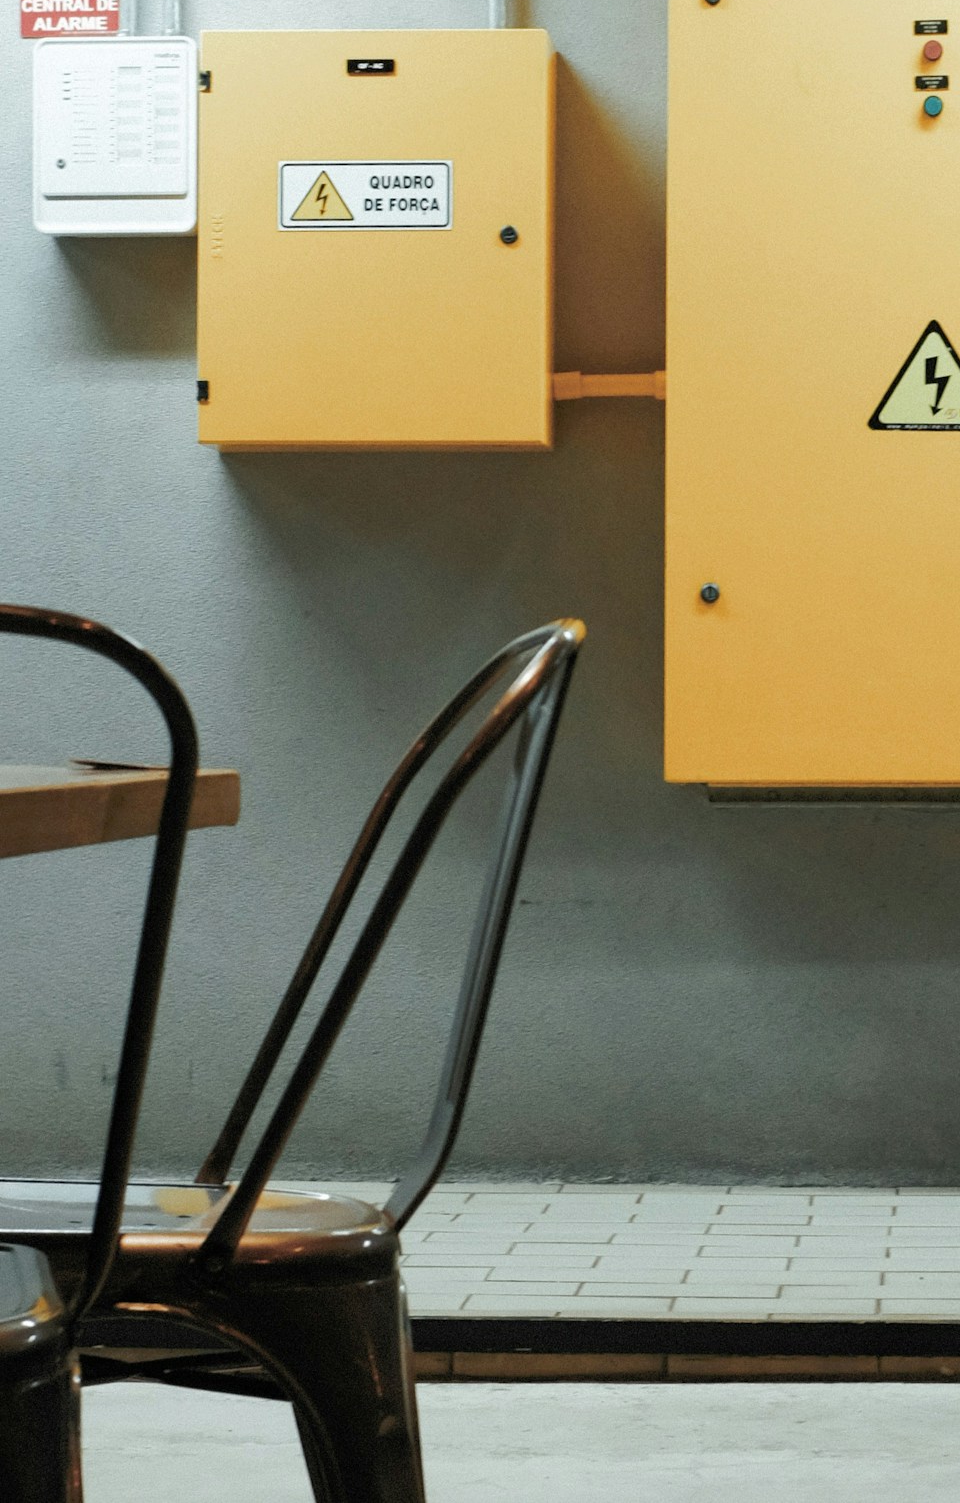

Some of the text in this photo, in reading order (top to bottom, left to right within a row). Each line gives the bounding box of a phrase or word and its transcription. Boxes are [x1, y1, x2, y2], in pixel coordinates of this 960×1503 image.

[32, 16, 108, 32] ALARME
[370, 175, 434, 189] QUADRO
[364, 198, 440, 215] DE FORÇA
